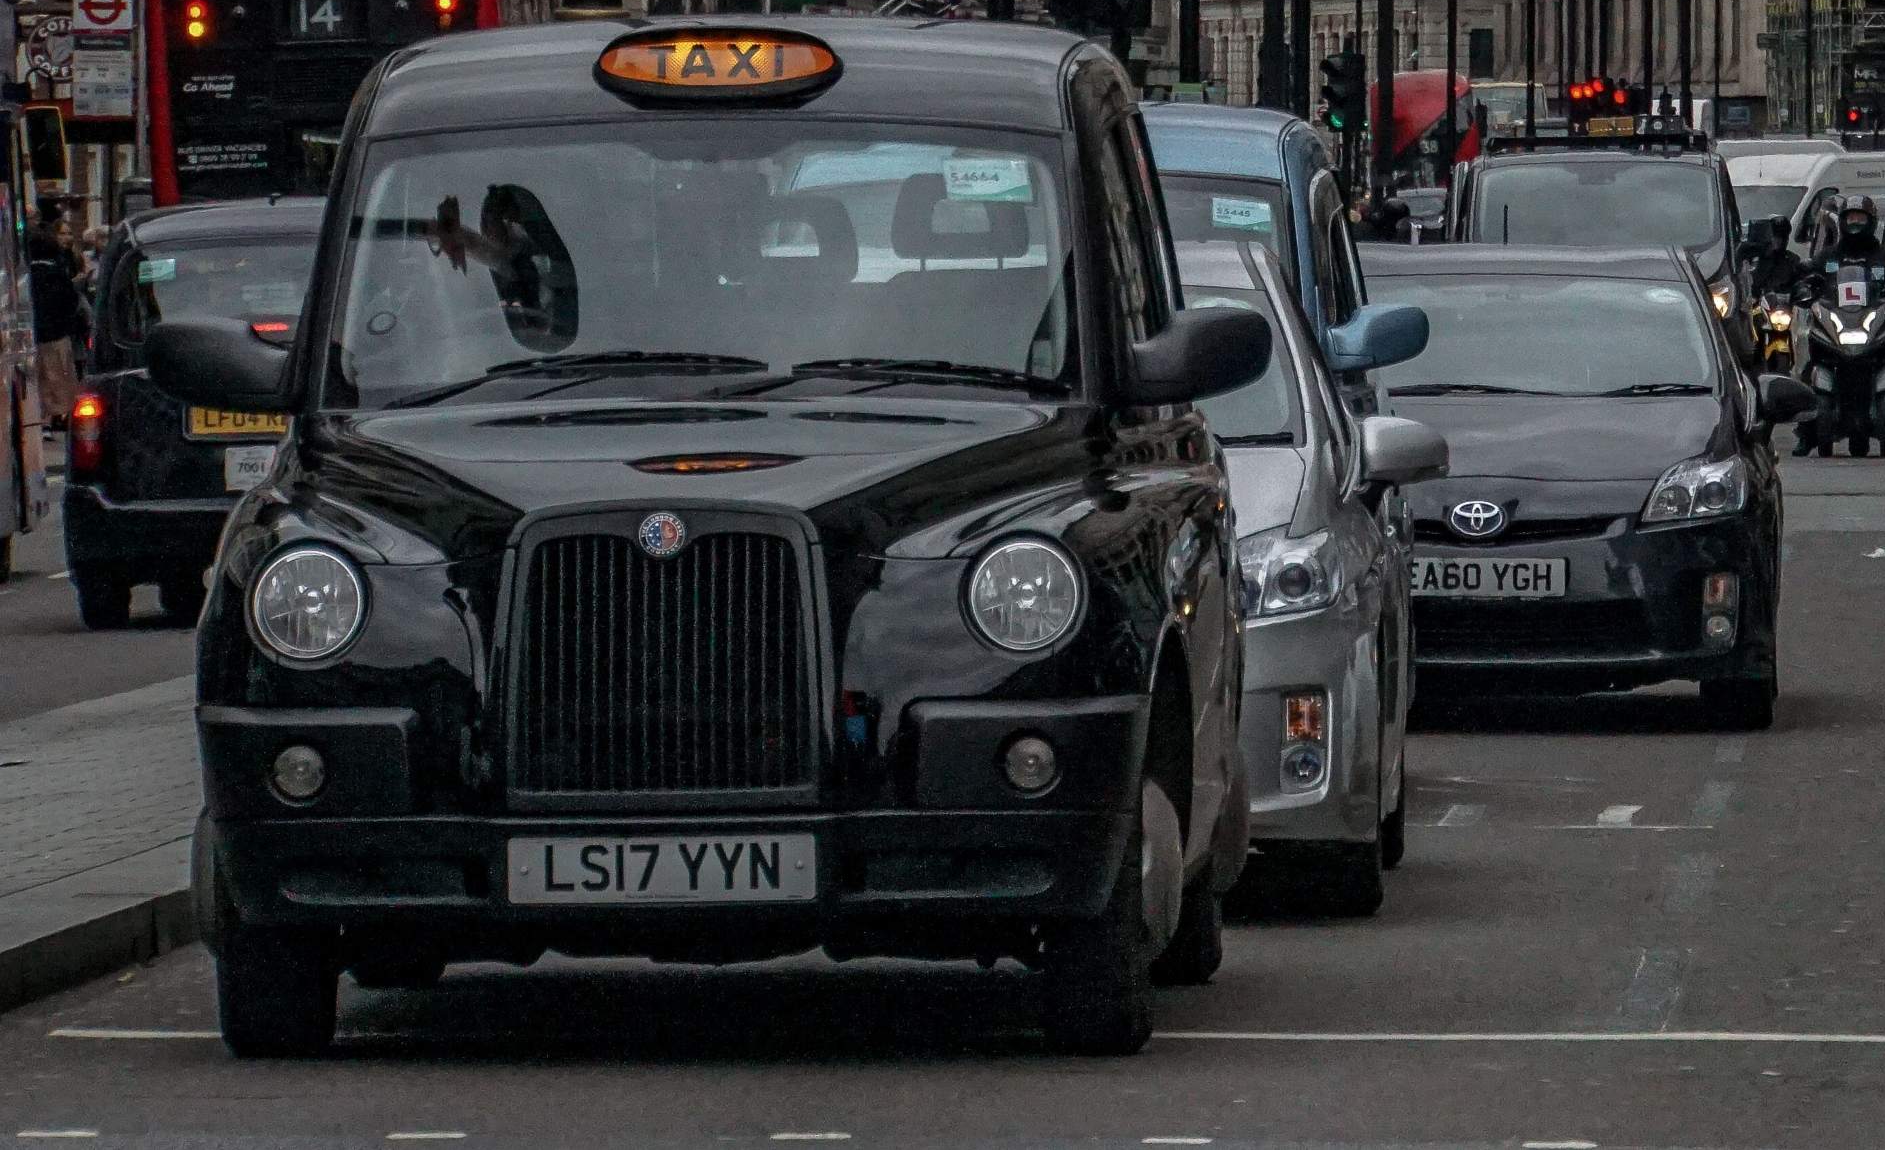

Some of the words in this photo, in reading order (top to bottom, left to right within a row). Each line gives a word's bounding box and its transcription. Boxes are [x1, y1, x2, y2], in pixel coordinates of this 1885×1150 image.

[649, 44, 784, 79] TAXI
[1846, 287, 1860, 300] L
[1411, 562, 1481, 591] EA60
[1493, 563, 1552, 591] YGH
[545, 844, 661, 893] LS17
[678, 842, 781, 891] YYN
